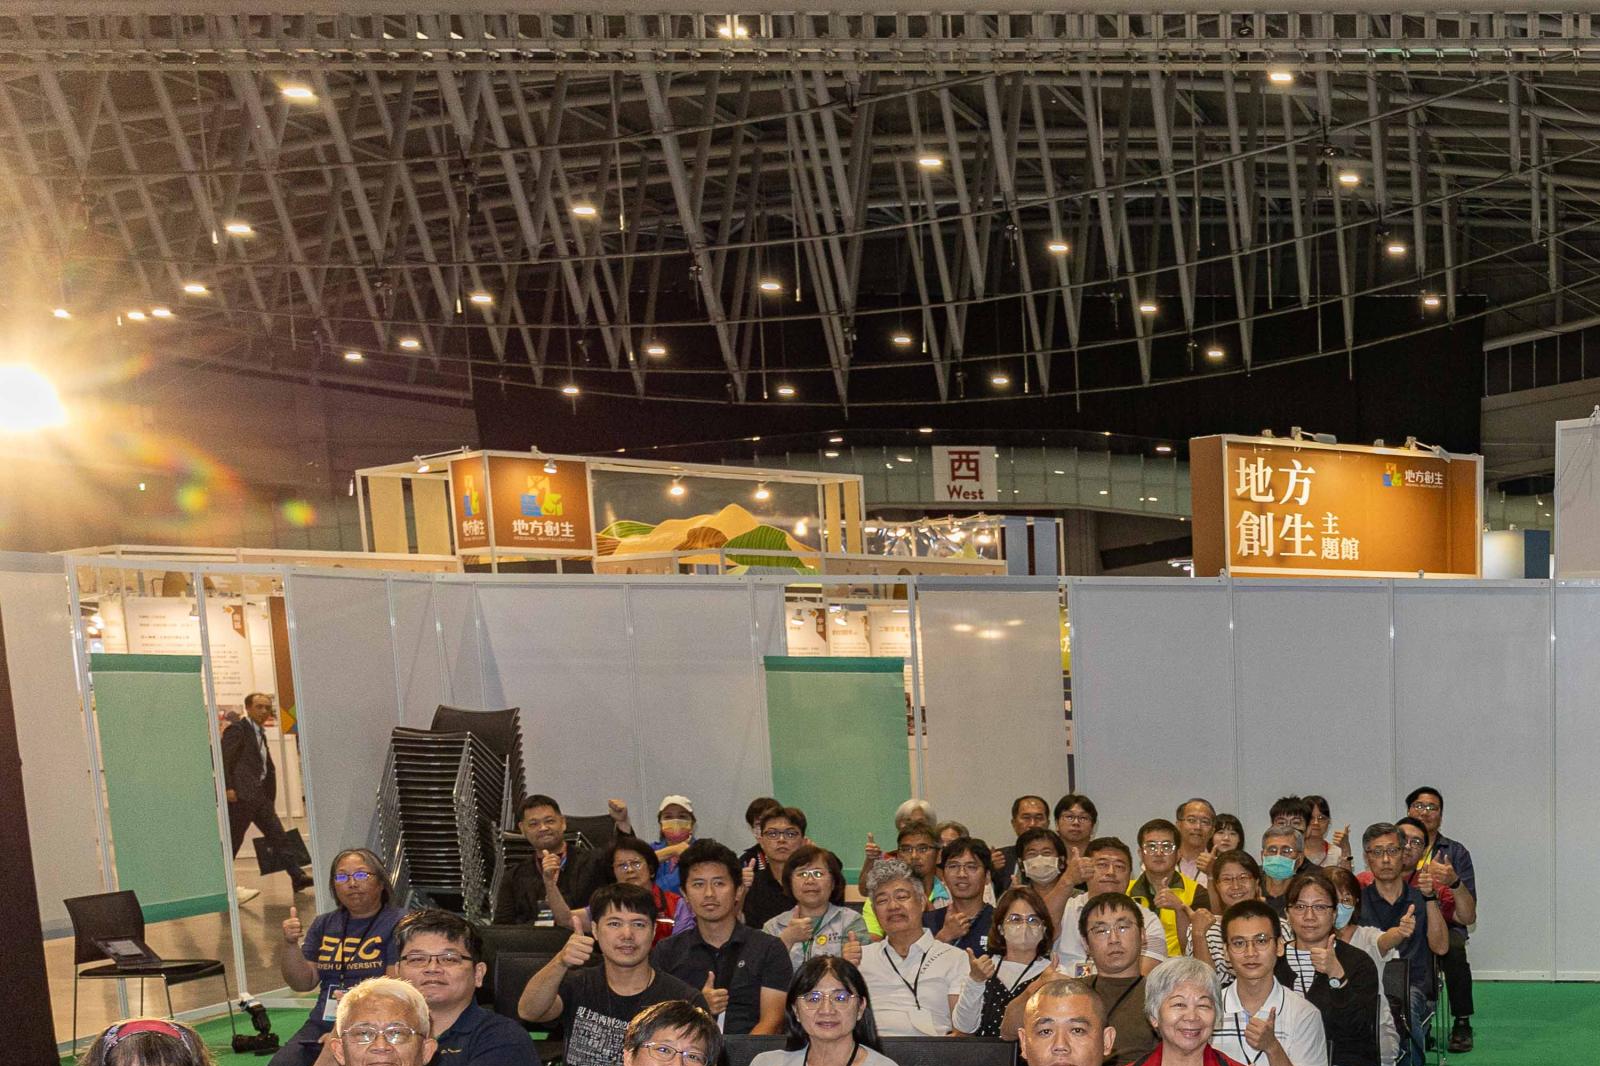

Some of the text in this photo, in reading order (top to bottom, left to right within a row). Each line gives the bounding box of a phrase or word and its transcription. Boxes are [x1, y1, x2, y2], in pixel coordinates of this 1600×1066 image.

[948, 451, 980, 481] 西
[1404, 469, 1443, 485] 地方創生
[947, 485, 984, 500] West
[1235, 457, 1316, 505] 地方
[512, 519, 575, 538] 地方創生
[1236, 510, 1317, 558] 創生
[1321, 512, 1340, 535] 主
[1321, 537, 1360, 561] 題館
